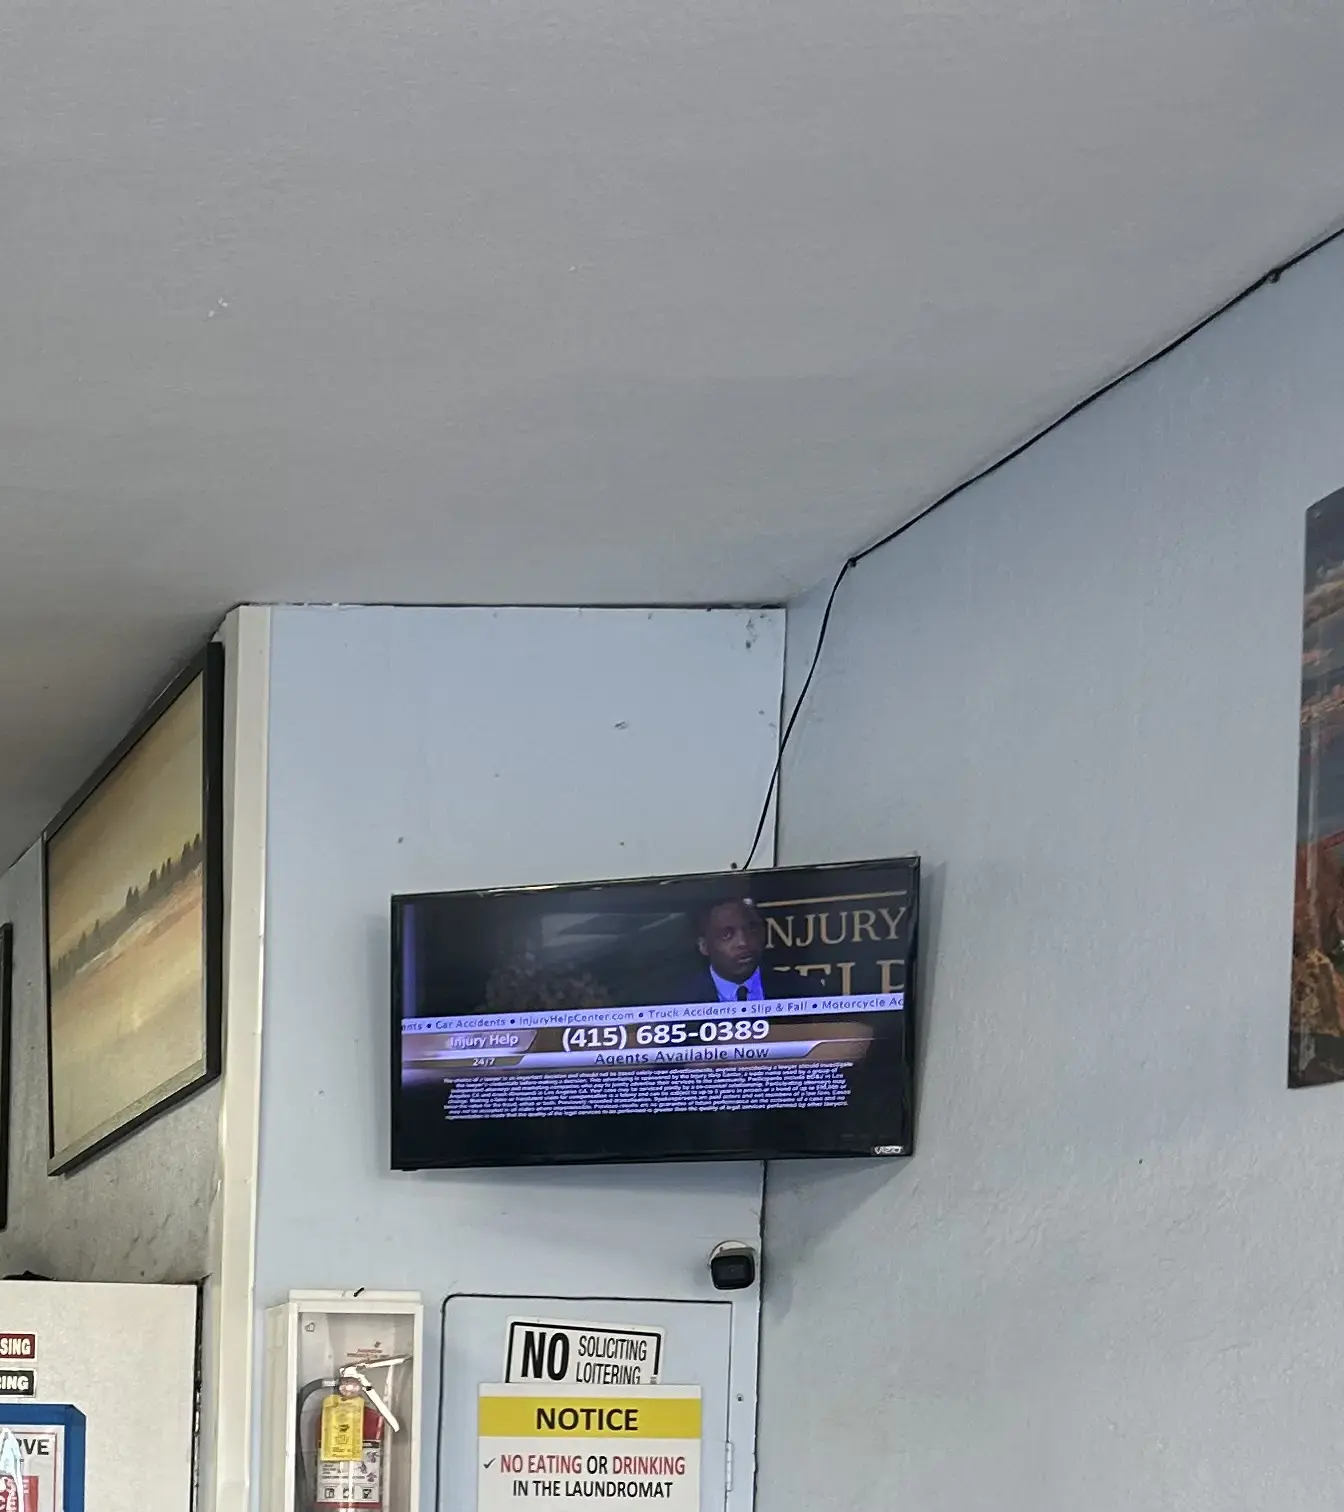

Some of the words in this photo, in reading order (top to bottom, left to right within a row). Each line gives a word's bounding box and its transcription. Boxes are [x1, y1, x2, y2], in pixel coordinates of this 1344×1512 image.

[765, 906, 906, 949] NJURY
[435, 1020, 453, 1029] Car
[456, 1017, 506, 1029] Accidents
[648, 1008, 679, 1019] Truck
[683, 1005, 737, 1016] Accidents
[751, 1002, 772, 1015] Slip
[776, 1002, 784, 1012] &
[787, 1000, 807, 1012] Fall
[822, 997, 886, 1012] Motorcycle
[450, 1035, 487, 1048] Injury
[489, 1032, 519, 1046] Help
[562, 1025, 627, 1052] (415)
[636, 1020, 770, 1045] 685-0389
[473, 1057, 495, 1066] 24/7
[595, 1052, 649, 1065] Agents
[656, 1047, 731, 1062] Available
[733, 1047, 769, 1059] Now
[521, 1330, 569, 1381] NO
[577, 1334, 647, 1361] SOLICITING
[575, 1362, 642, 1385] LOITERING
[536, 1408, 640, 1431] NOTICE
[500, 1454, 523, 1474] NO
[527, 1454, 582, 1475] EATING
[588, 1455, 609, 1475] OR
[612, 1455, 686, 1476] DRINKING
[513, 1479, 528, 1496] IN
[532, 1479, 561, 1497] THE
[565, 1480, 674, 1498] LAUNDROMAT
